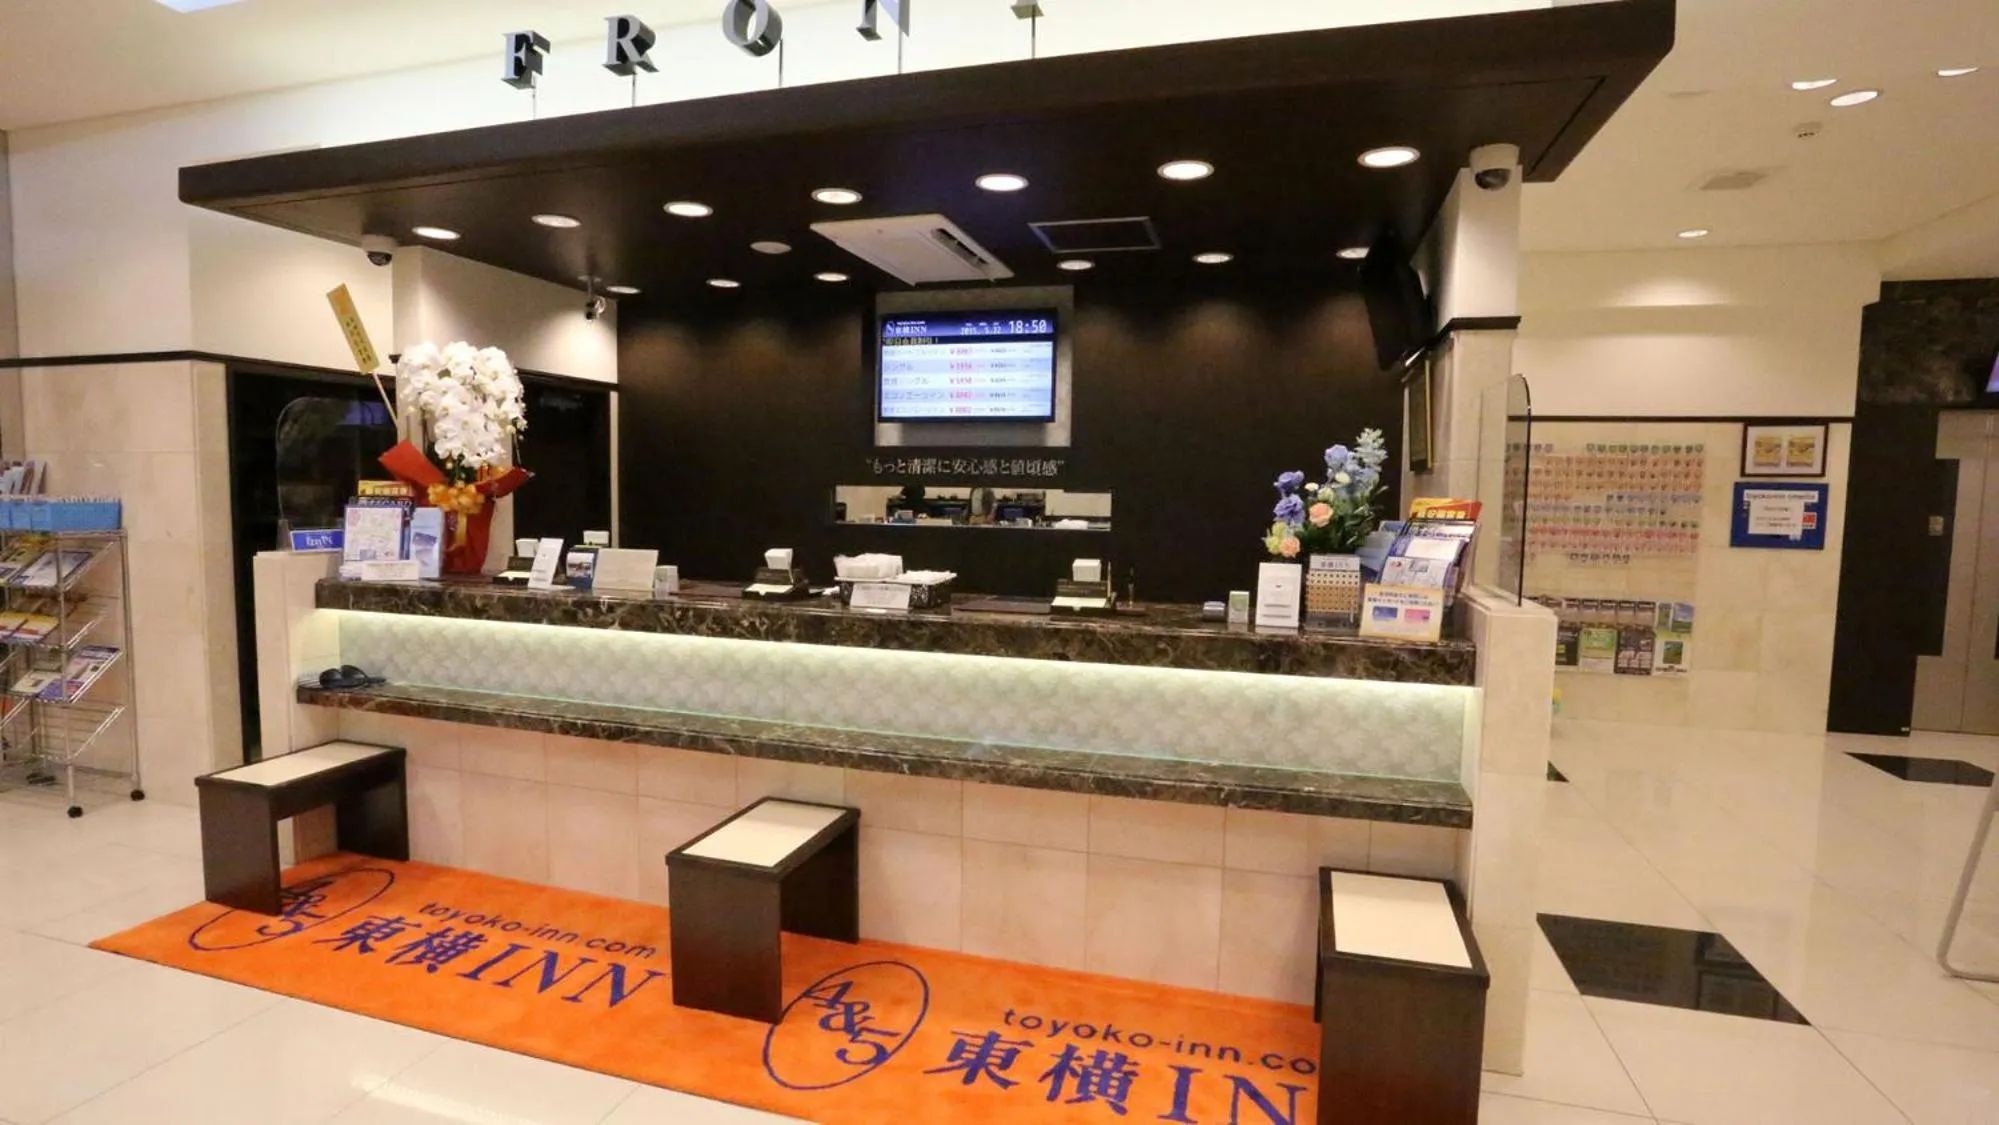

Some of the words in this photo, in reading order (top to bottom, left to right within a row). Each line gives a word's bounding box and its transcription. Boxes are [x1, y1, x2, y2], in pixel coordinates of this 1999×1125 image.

[1009, 320, 1047, 333] 18:50
[314, 914, 668, 1007] 東横INN
[418, 901, 658, 960] toyoko-inn.com
[1002, 1007, 1318, 1075] toyoko-inn.co
[924, 1029, 1307, 1125] 東横IN
